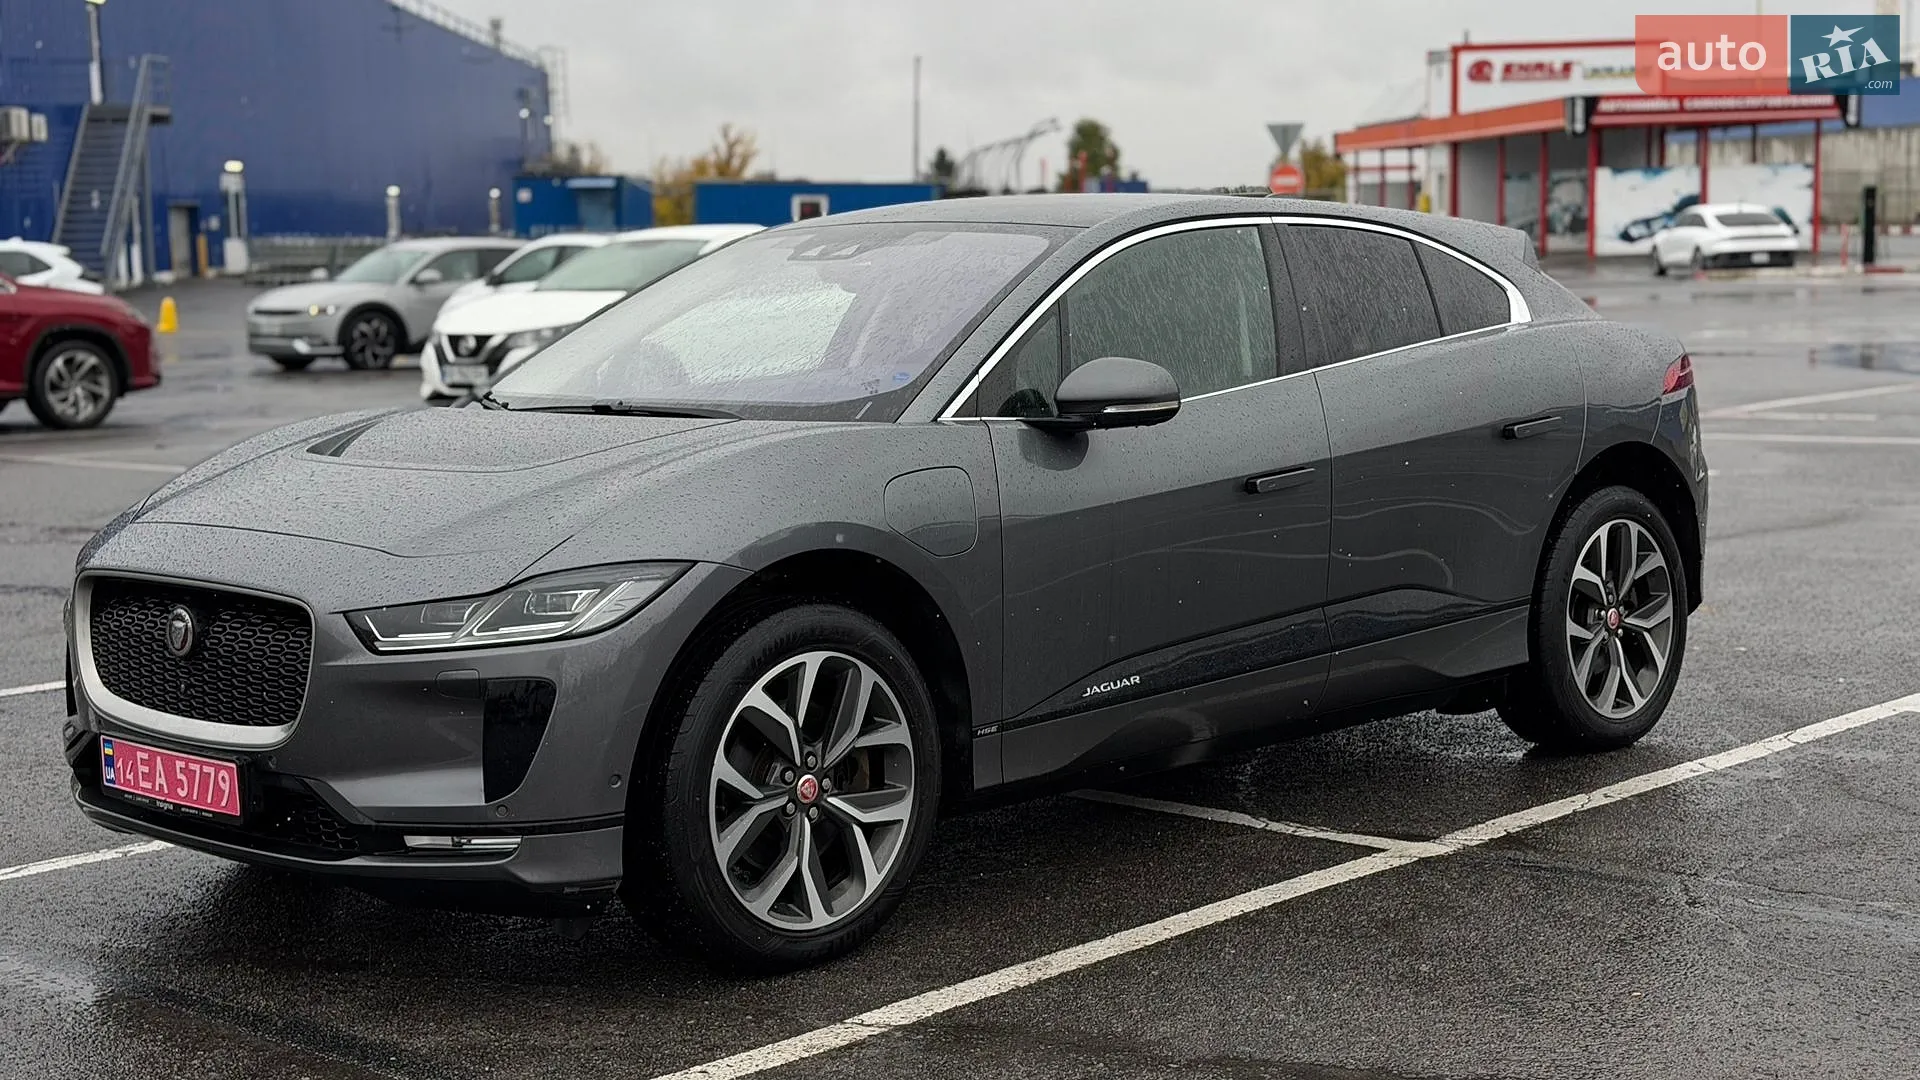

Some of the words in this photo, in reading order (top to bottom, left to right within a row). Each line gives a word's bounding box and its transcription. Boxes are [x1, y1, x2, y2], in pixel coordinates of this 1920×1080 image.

[1082, 675, 1142, 698] JAGUAR
[977, 724, 999, 736] HSE
[105, 766, 115, 781] UA
[176, 760, 230, 807] 5779
